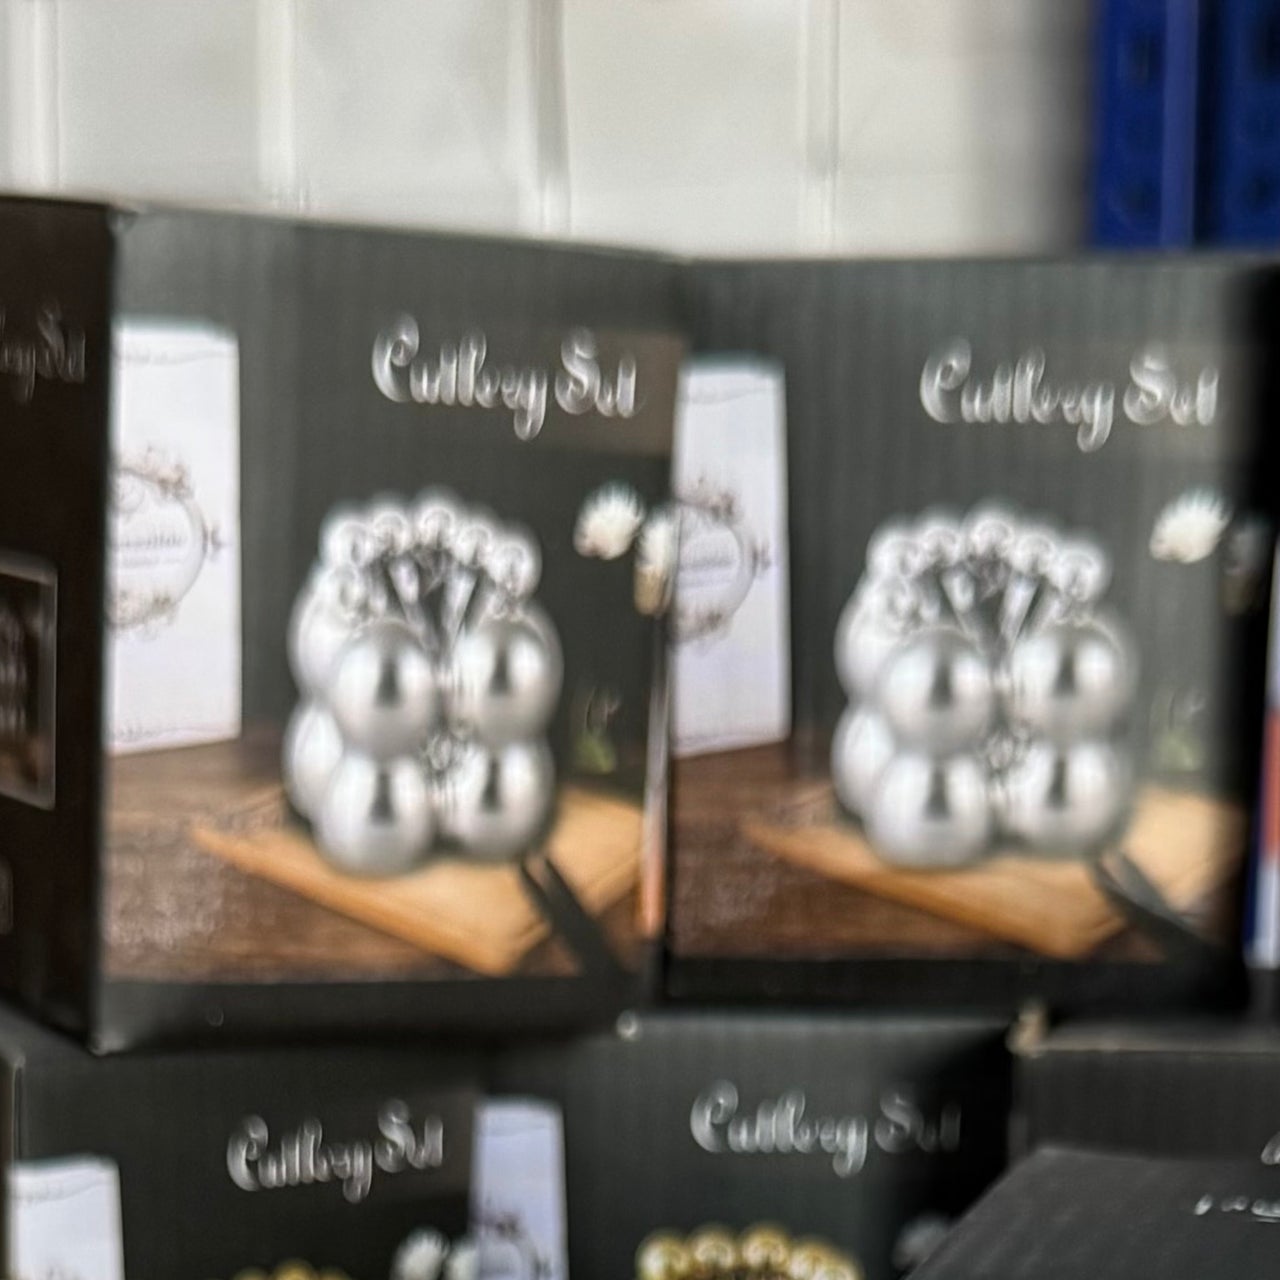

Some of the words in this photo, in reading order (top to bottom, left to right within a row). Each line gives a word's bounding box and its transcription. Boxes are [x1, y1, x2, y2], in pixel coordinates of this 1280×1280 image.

[371, 311, 548, 441] Cutlery
[554, 325, 642, 419] Set
[919, 338, 1116, 452] Cutlery
[1122, 342, 1220, 426] Set
[226, 1114, 374, 1204] Cutlery
[689, 1078, 869, 1179] Cutlery
